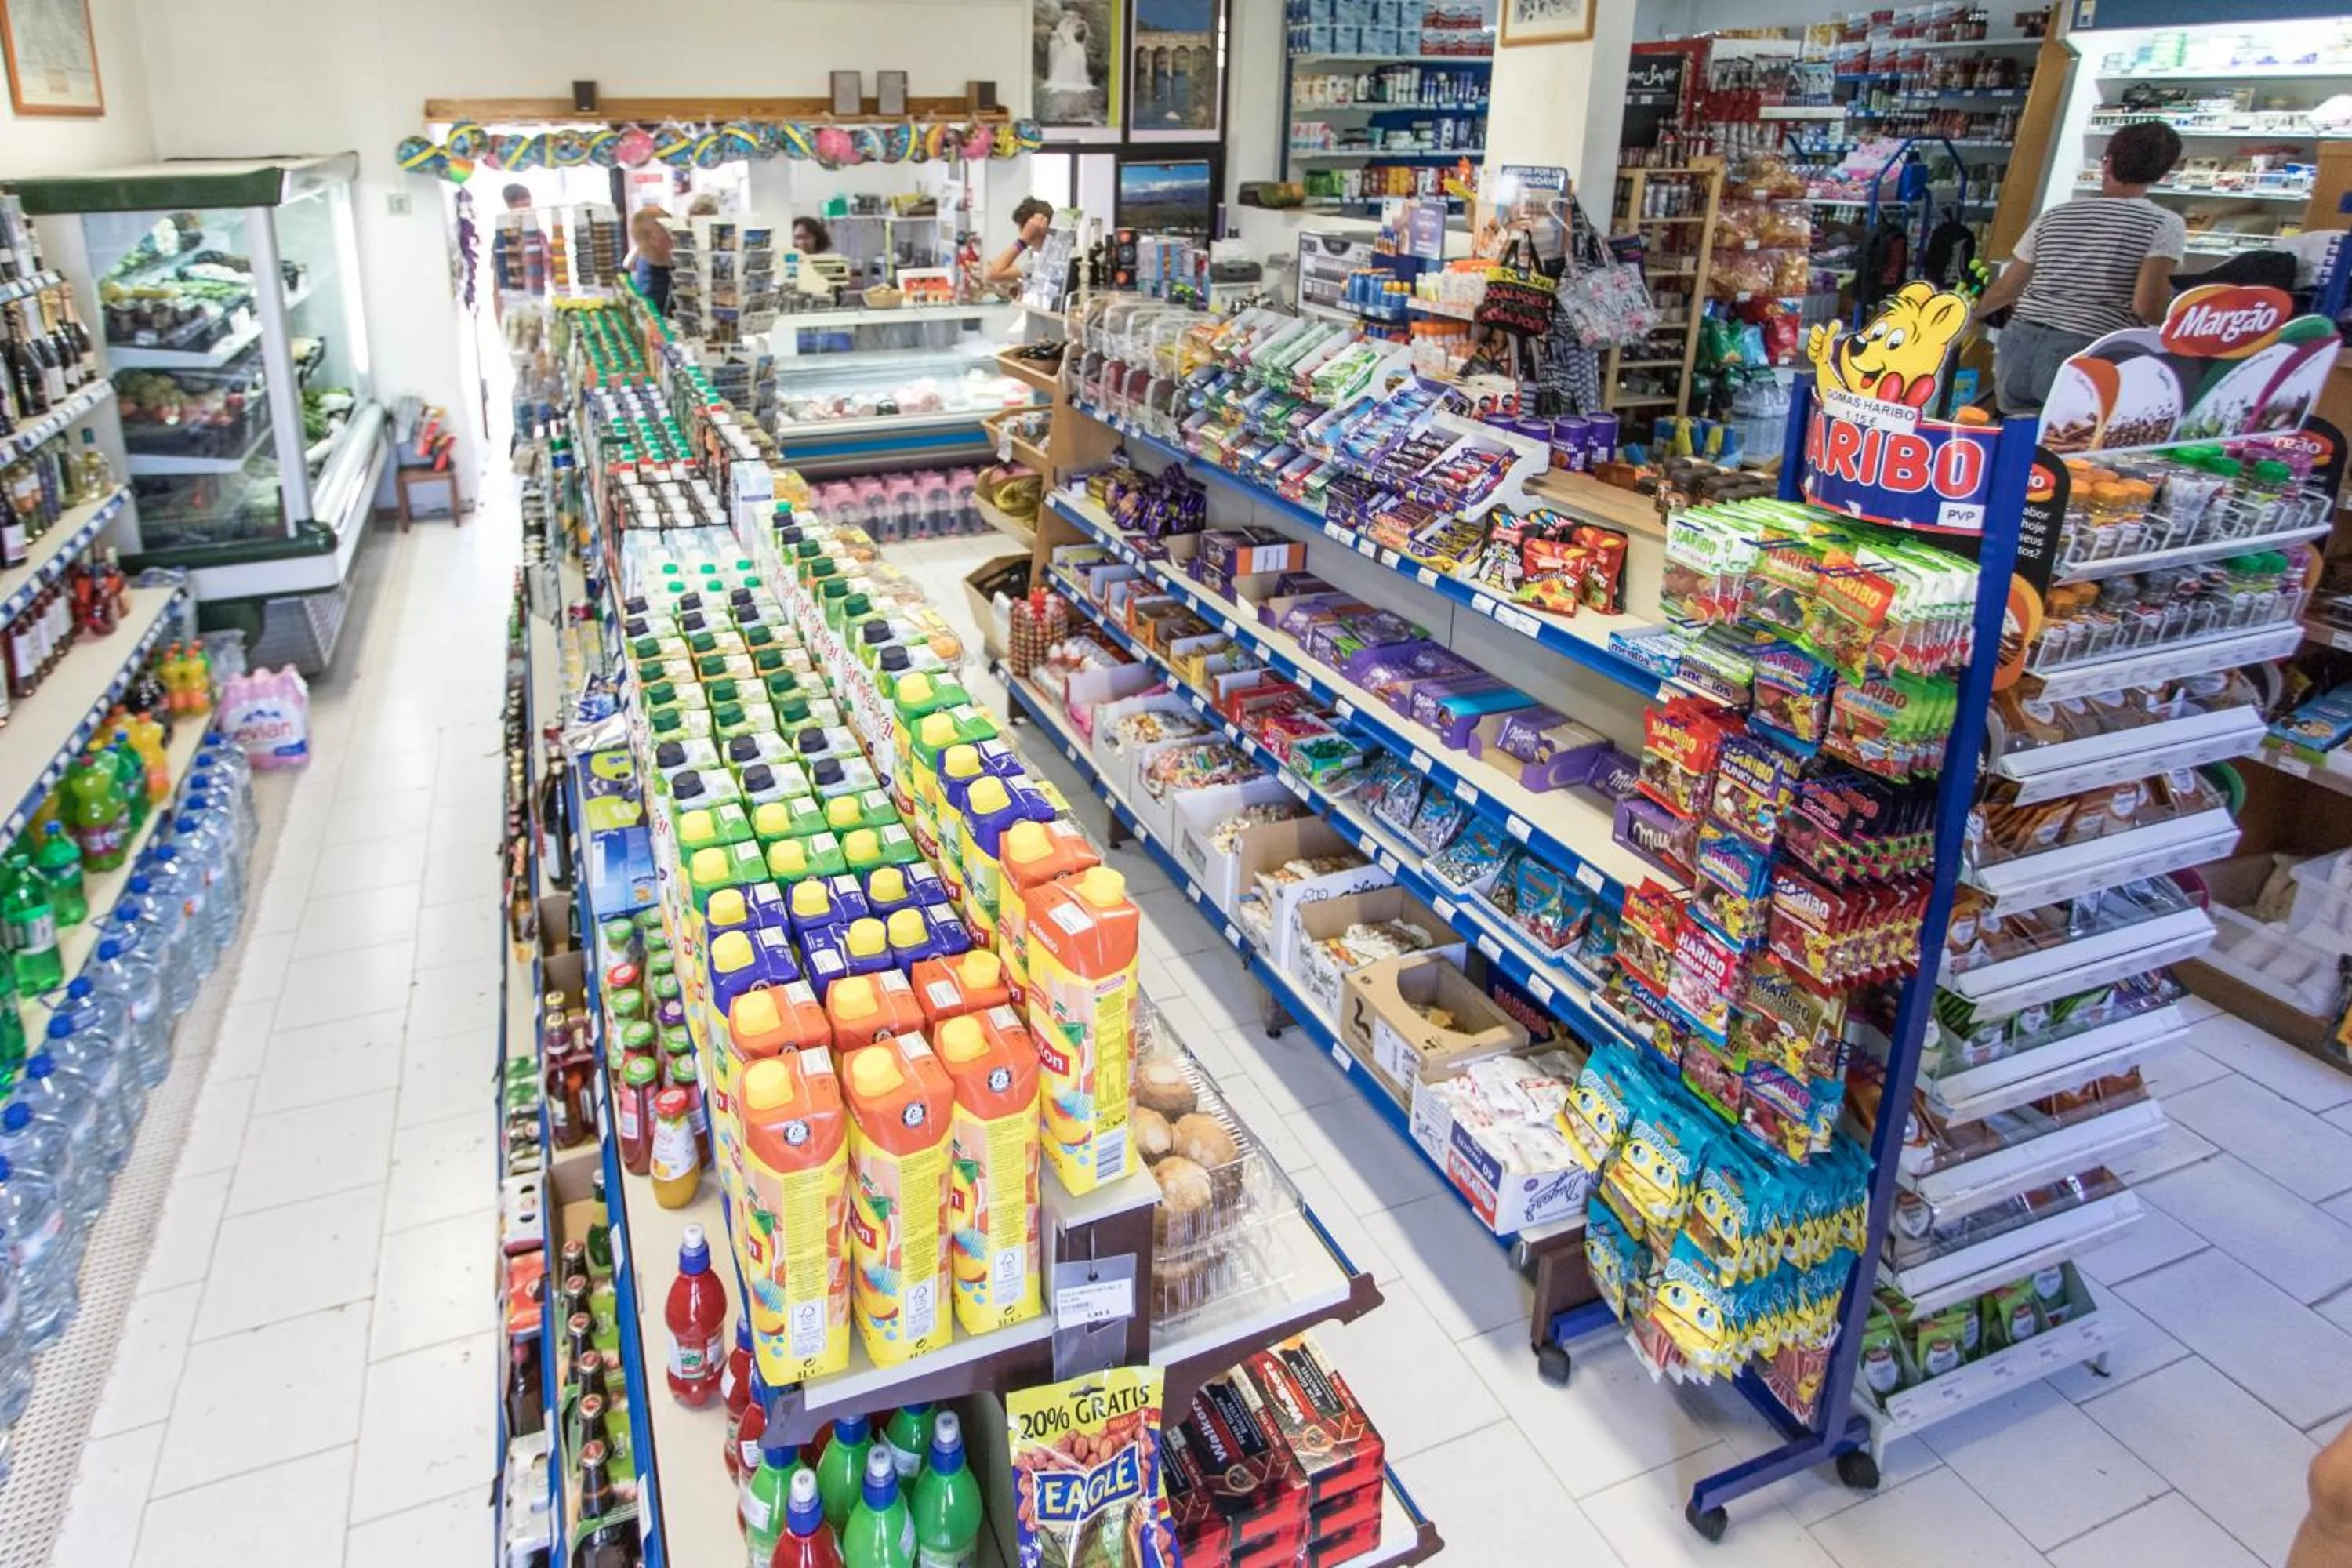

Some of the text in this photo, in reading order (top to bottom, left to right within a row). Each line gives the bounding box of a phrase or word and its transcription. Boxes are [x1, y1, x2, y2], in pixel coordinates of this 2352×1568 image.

[2172, 301, 2278, 343] Margão
[1825, 388, 1916, 422] GOMAS HARIBO
[1805, 411, 1986, 500] ARIBO
[2270, 434, 2322, 456] rgão
[1947, 509, 1976, 521] PVP
[2023, 507, 2050, 520] abor
[1671, 526, 1718, 556] HARIBO
[1766, 546, 1815, 572] HARIB
[1833, 572, 1882, 608] ARIBO
[1611, 641, 1650, 666] mentos
[1861, 679, 1908, 710] RIBO
[1678, 931, 1726, 978] HARIBO
[1264, 1360, 1305, 1425] Walkers
[1020, 1406, 1070, 1439] 20%
[1075, 1385, 1150, 1425] GRATIS
[1191, 1396, 1229, 1463] Walkers
[1044, 1456, 1133, 1515] EAGLE
